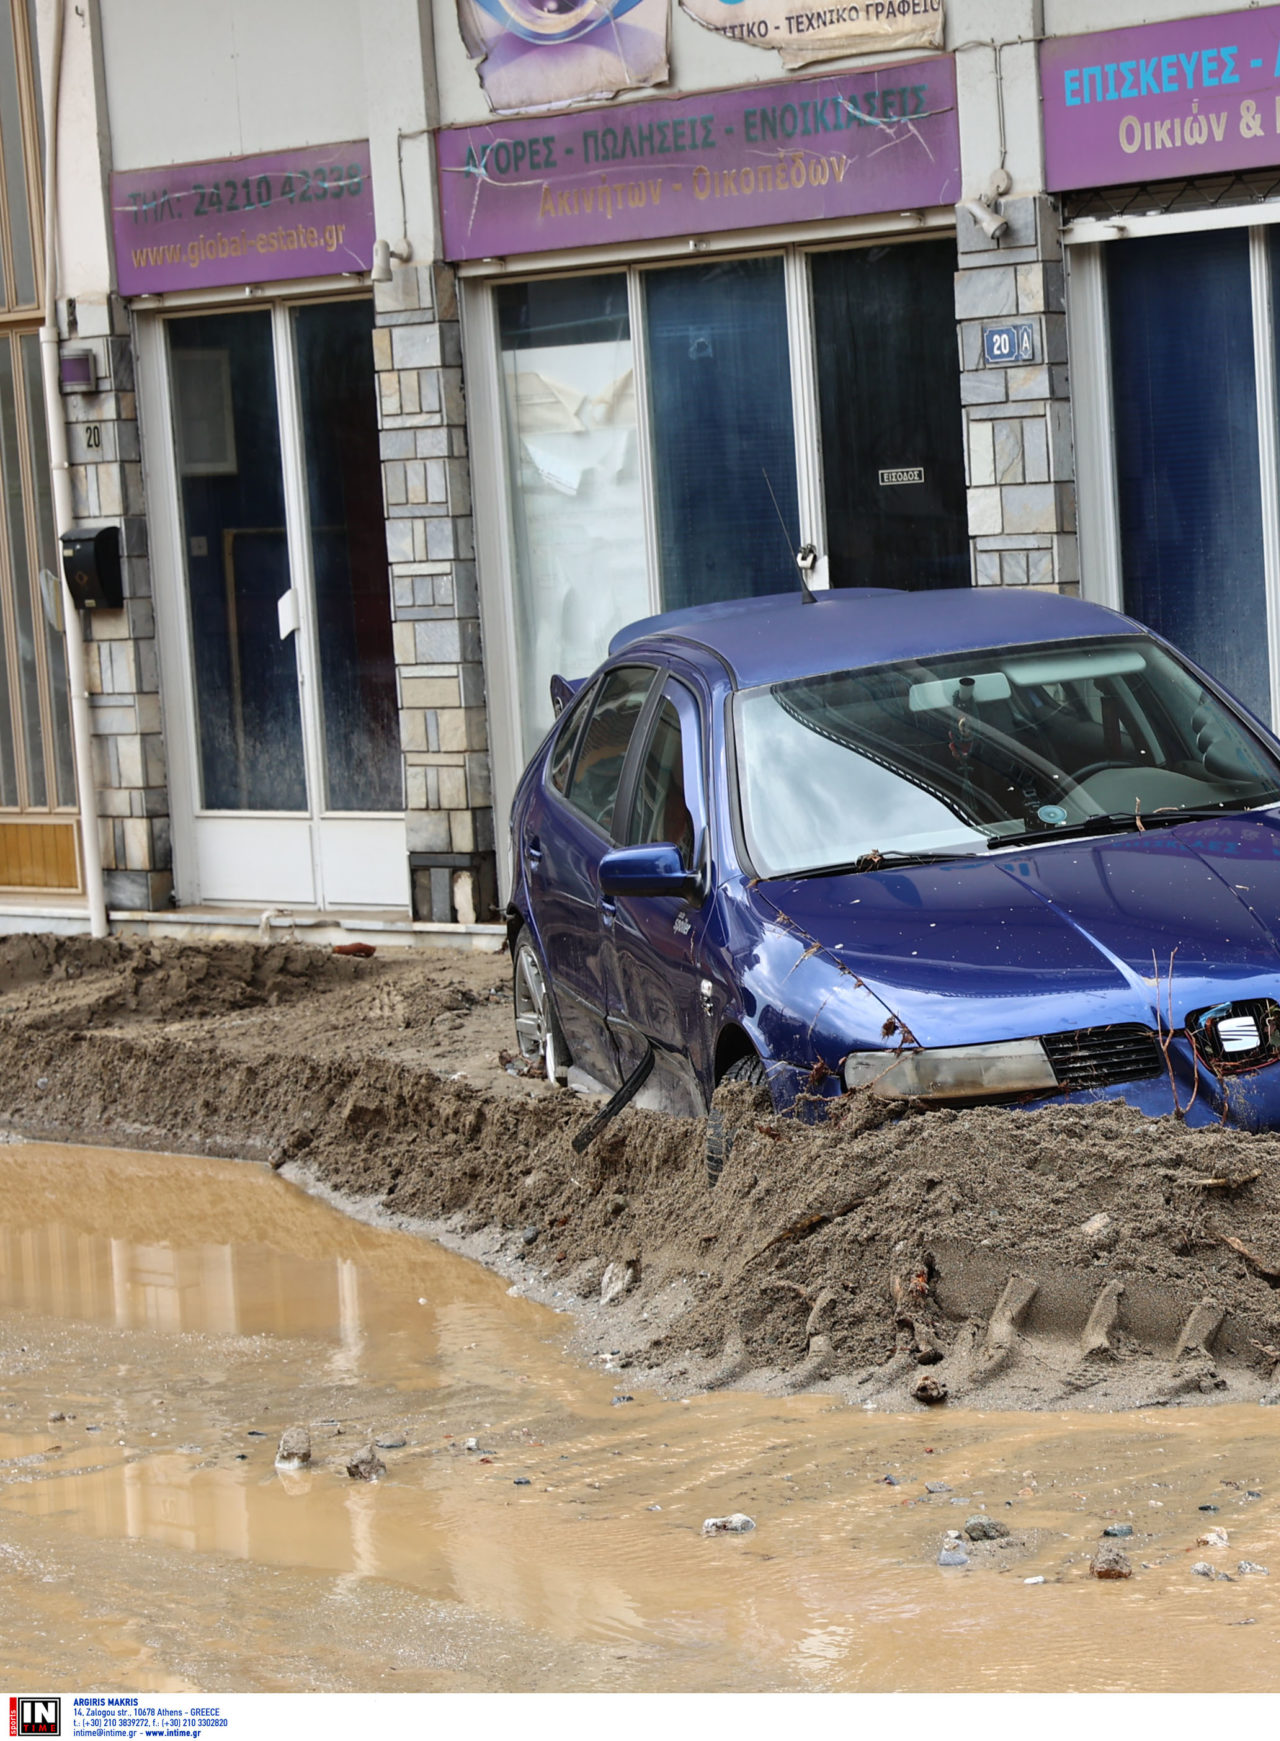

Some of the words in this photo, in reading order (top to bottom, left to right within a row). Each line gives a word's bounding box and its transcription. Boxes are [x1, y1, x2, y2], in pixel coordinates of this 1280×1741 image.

[785, 5, 859, 34] ΤΕΧΝΙΚΟ
[1064, 45, 1240, 106] ΕΠΙΣΚΕΥΕΣ
[583, 113, 716, 164] ΠΩΛΗΣΕΙΣ
[744, 84, 928, 143] ΕΝΟΙΚΙΑΣΕΙΣ
[1118, 98, 1227, 153] Οικιών
[1239, 99, 1264, 138] &
[192, 174, 272, 217] 24210
[539, 172, 663, 220] Ακινήτων
[692, 152, 848, 199] Οικοπέδων
[132, 224, 346, 269] www.global-estate.gr
[992, 333, 1010, 355] 20
[85, 425, 101, 448] 20
[883, 471, 920, 482] ΕΙΣΟΔΟΣ
